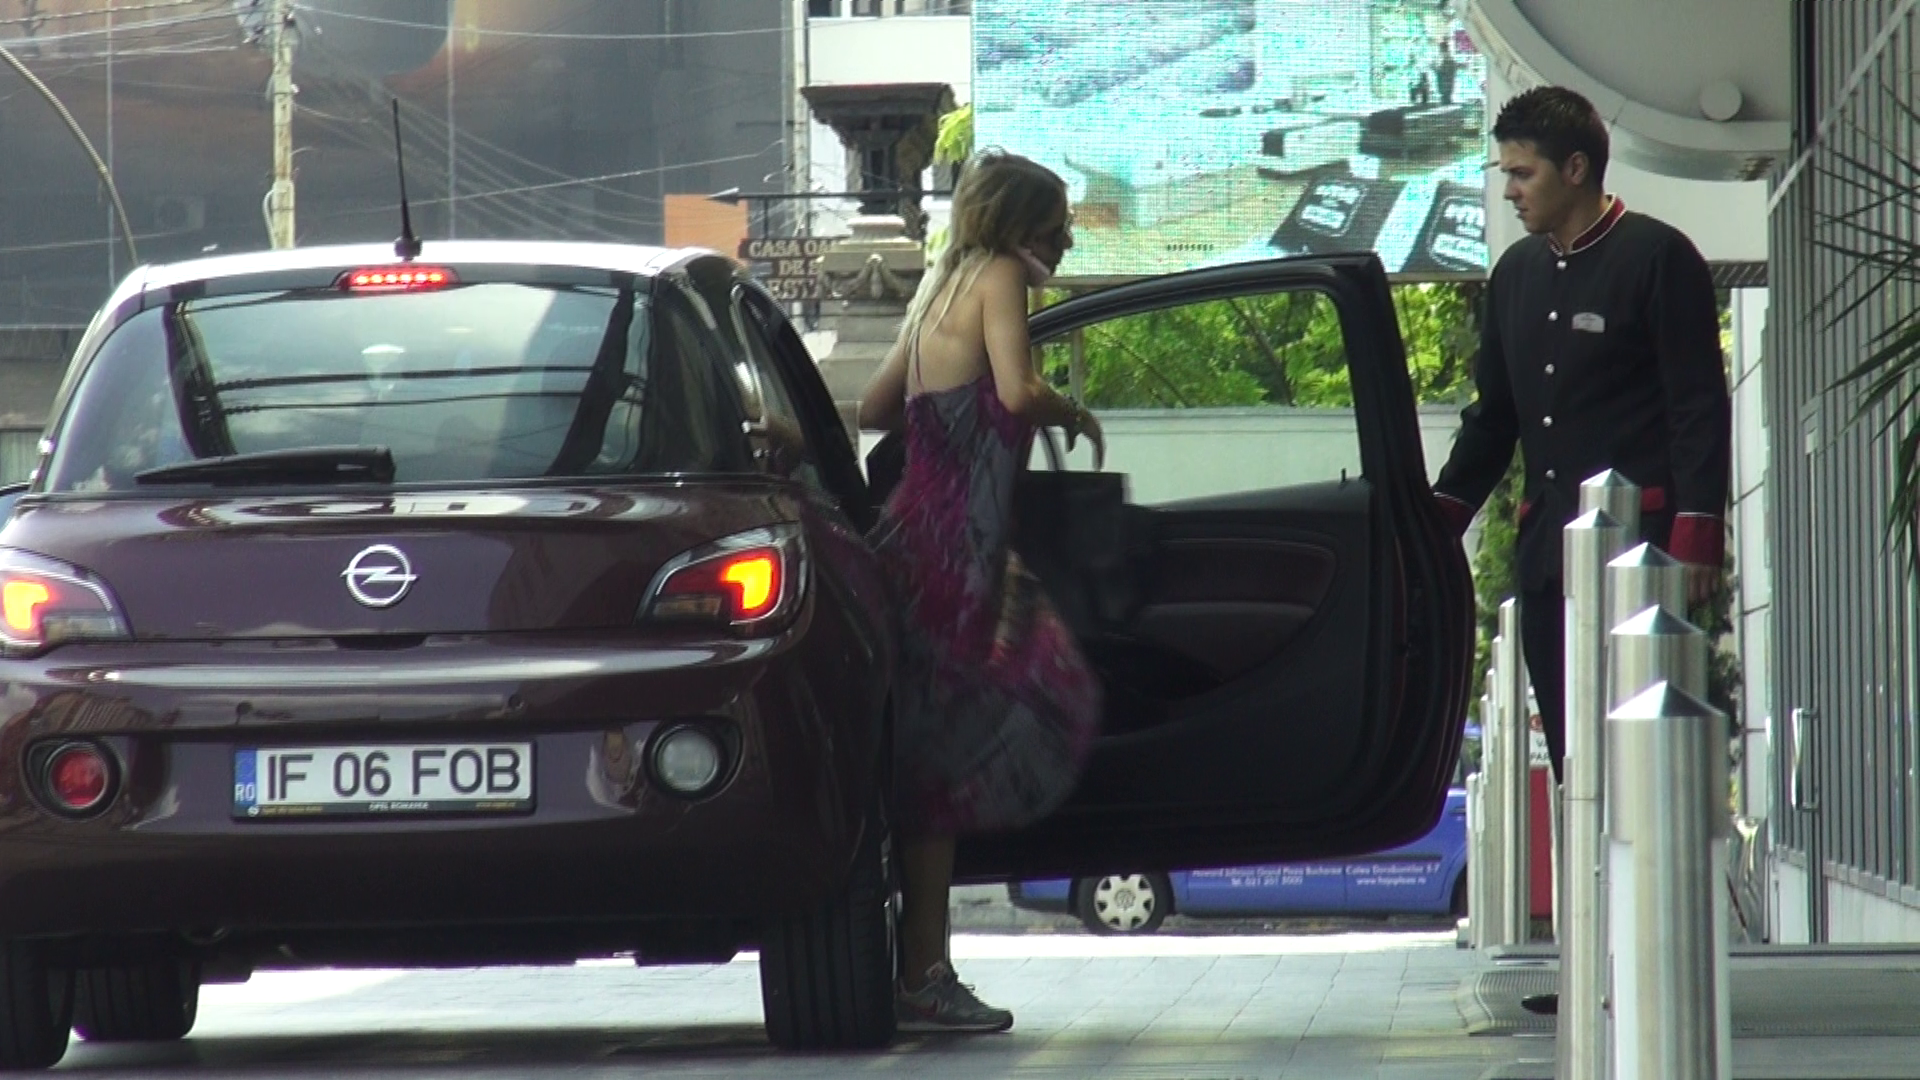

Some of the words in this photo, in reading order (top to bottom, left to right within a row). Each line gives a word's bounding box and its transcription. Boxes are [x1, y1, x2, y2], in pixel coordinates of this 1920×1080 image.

[749, 240, 802, 257] CASA
[779, 260, 805, 276] DE
[267, 753, 314, 801] IF
[333, 750, 391, 798] 06
[412, 748, 521, 796] FOB
[234, 783, 256, 802] RO
